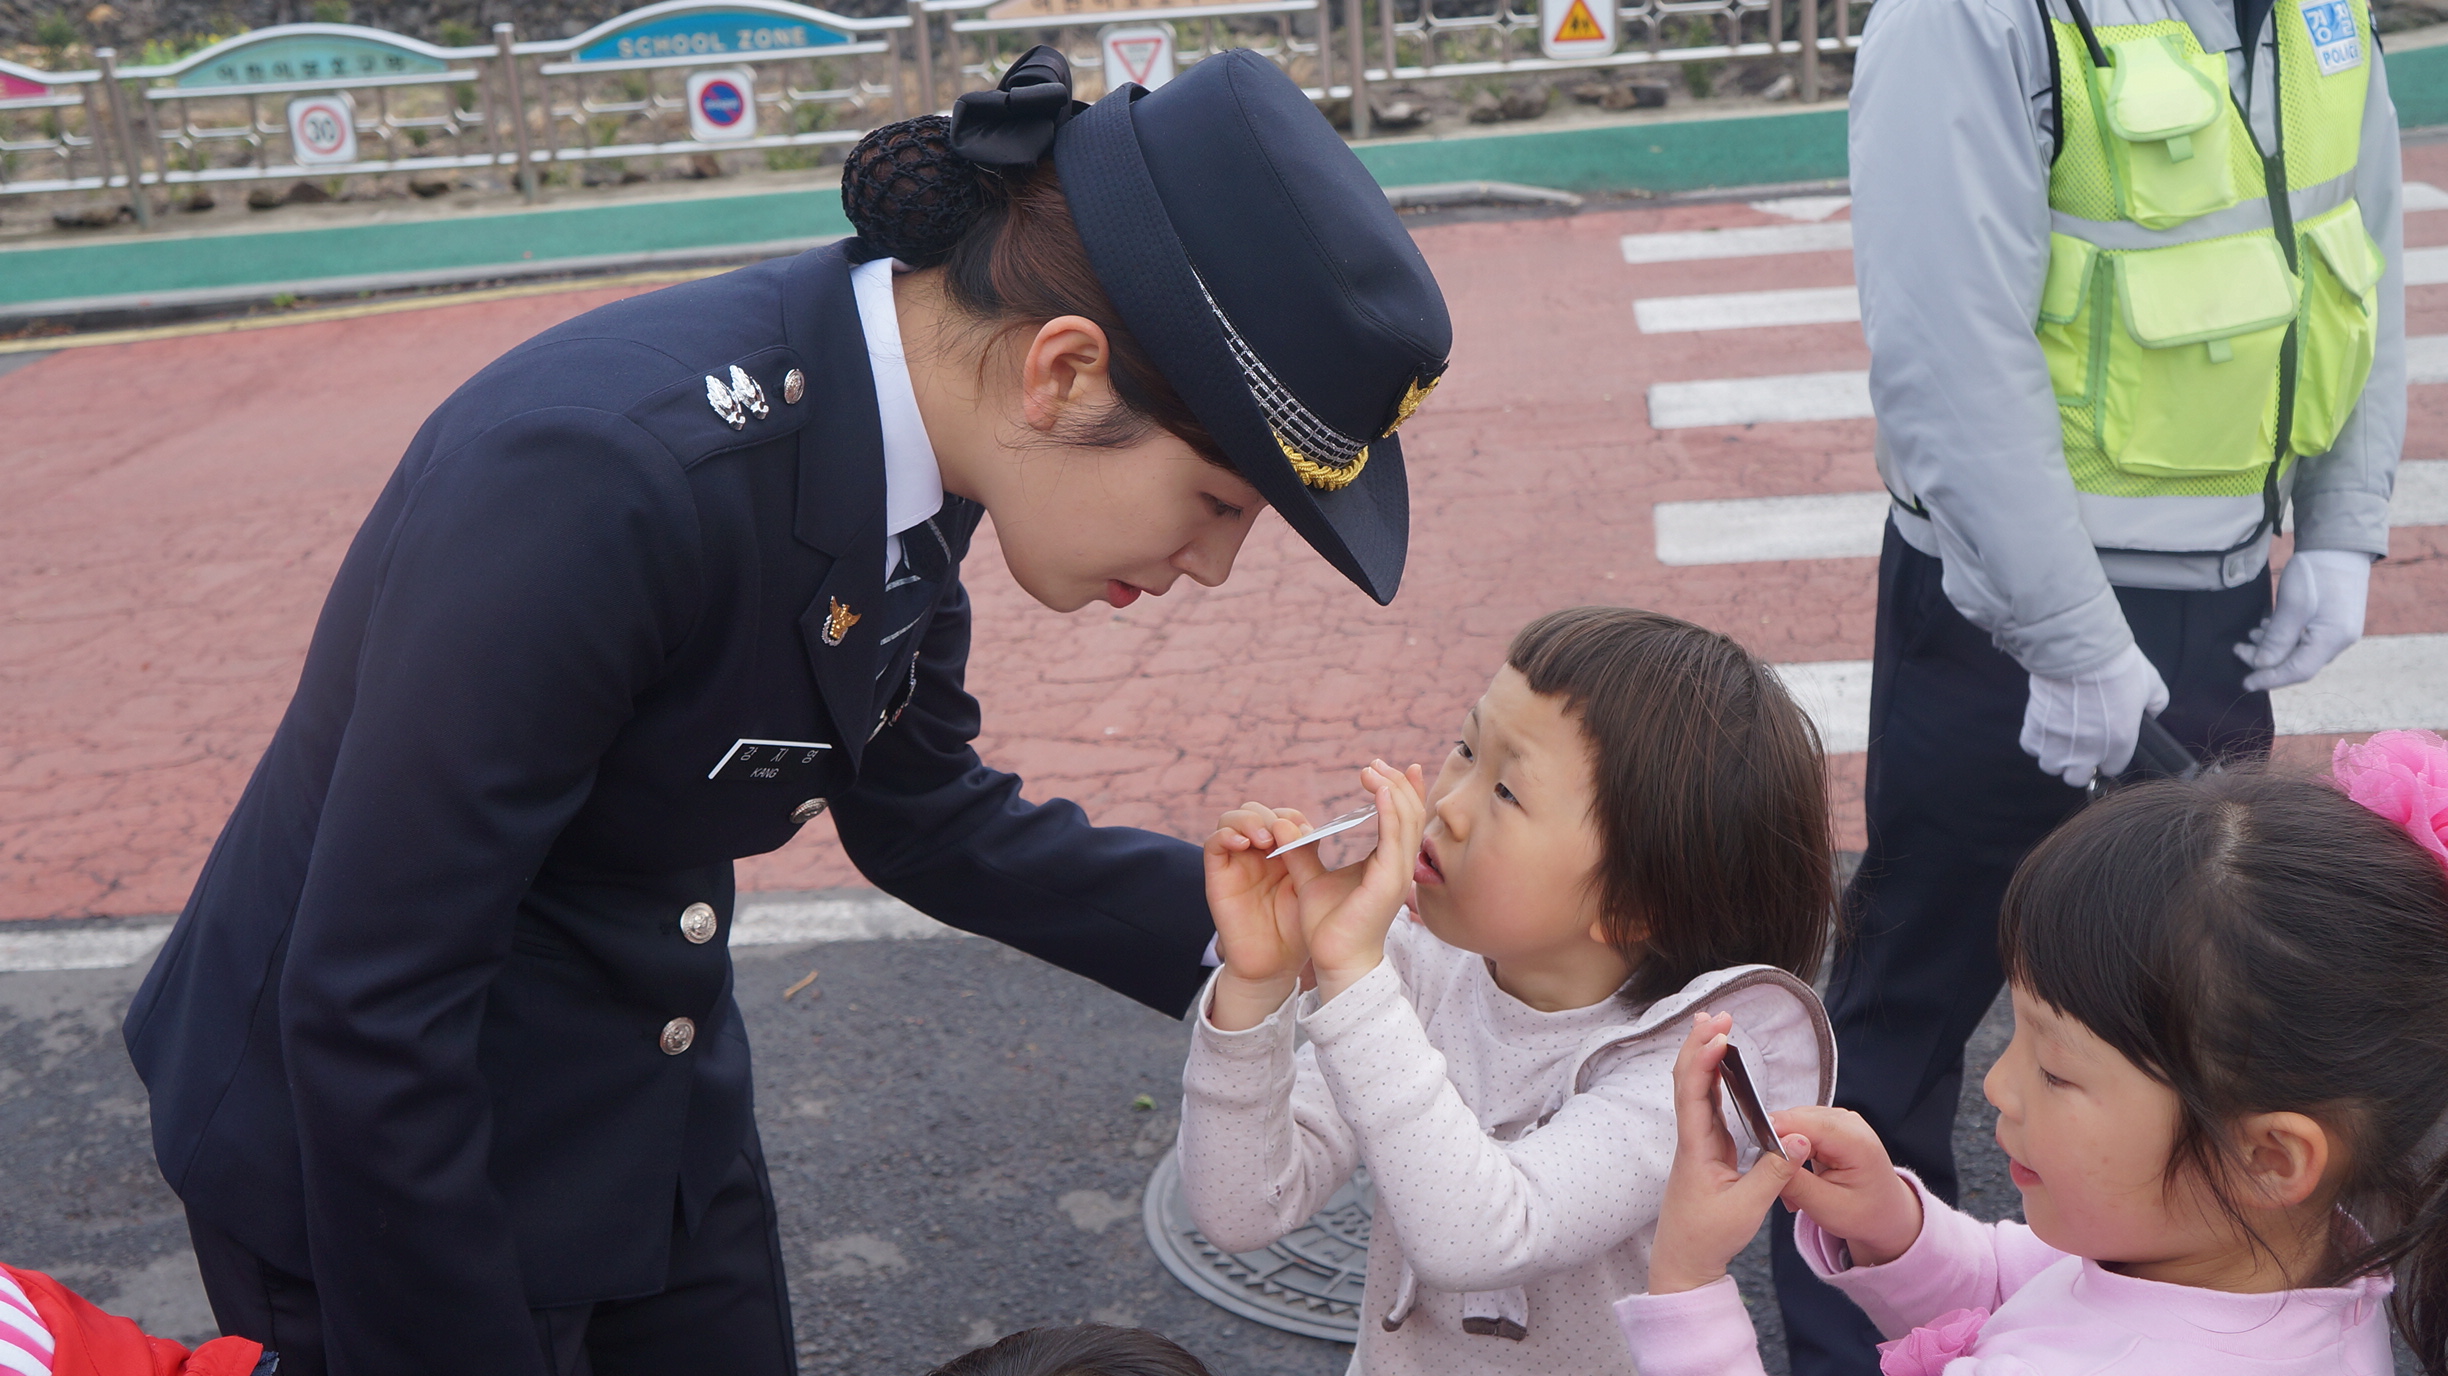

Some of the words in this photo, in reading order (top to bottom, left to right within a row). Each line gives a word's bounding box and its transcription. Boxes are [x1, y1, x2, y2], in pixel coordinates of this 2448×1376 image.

[2306, 3, 2355, 44] 경찰
[618, 32, 727, 58] SCHOOL
[737, 26, 807, 50] ZONE
[216, 53, 406, 83] 어린이보호구역
[306, 117, 337, 143] 30
[749, 767, 780, 779] KANG
